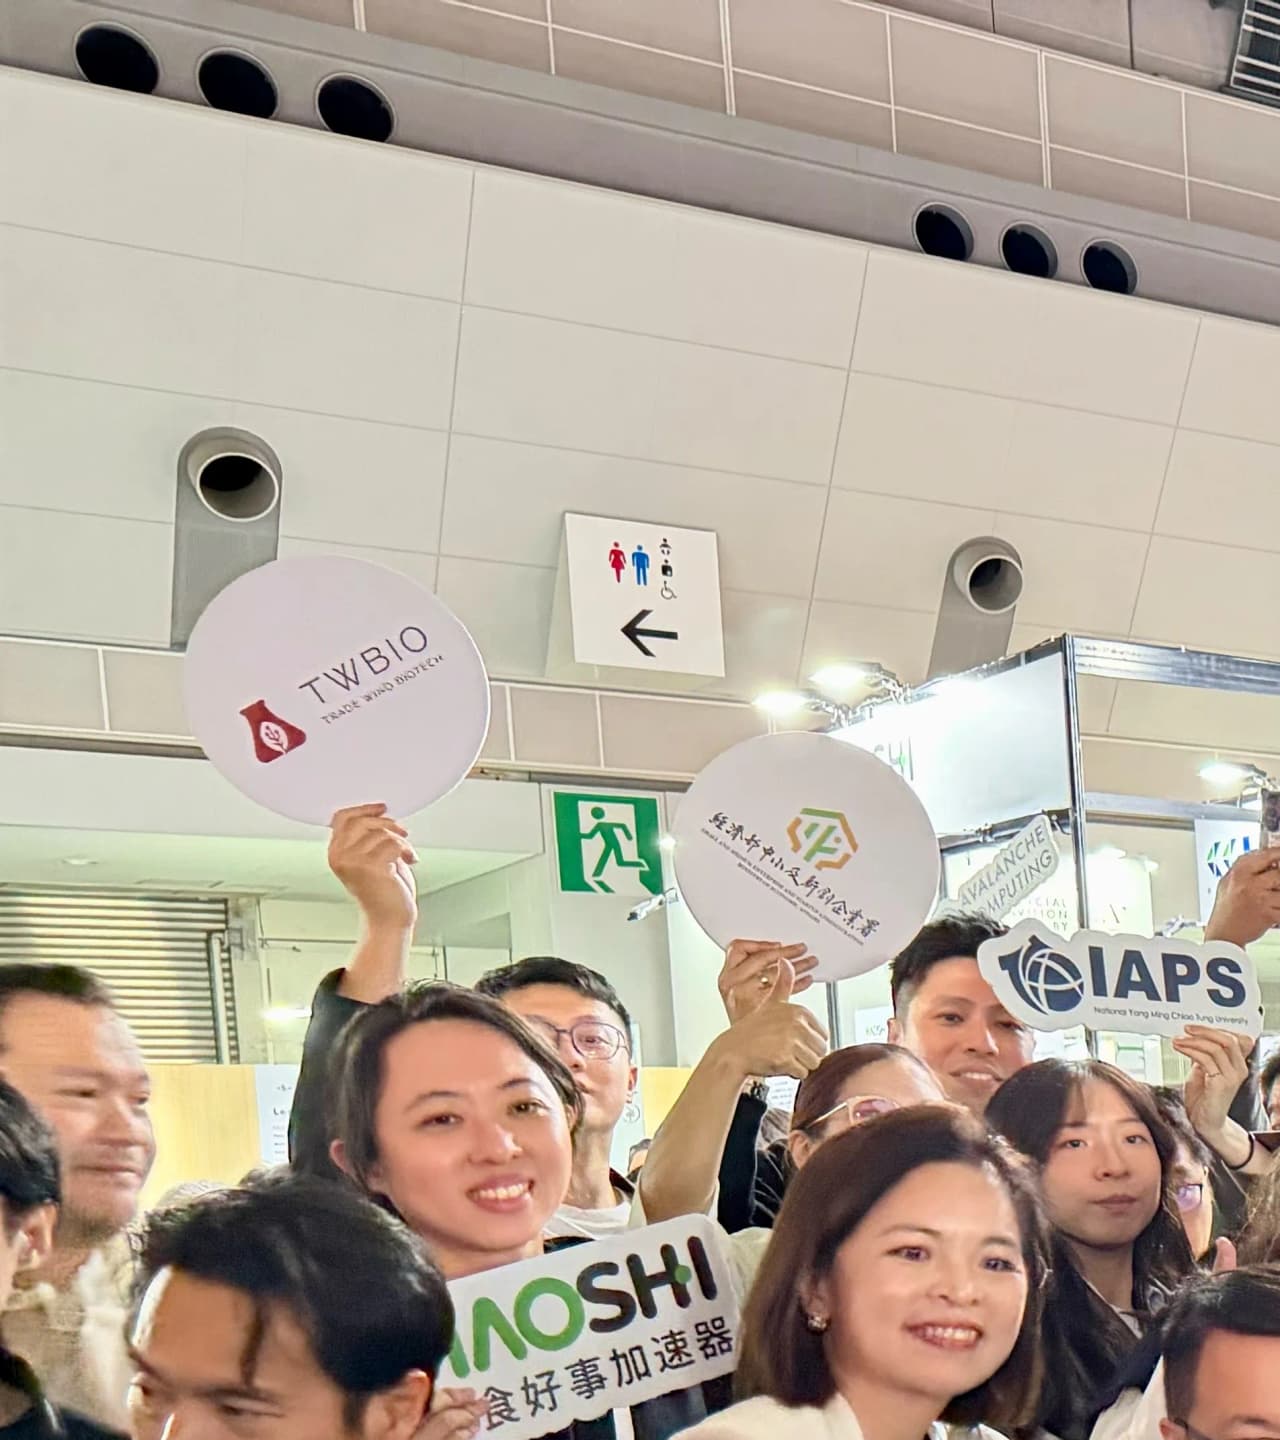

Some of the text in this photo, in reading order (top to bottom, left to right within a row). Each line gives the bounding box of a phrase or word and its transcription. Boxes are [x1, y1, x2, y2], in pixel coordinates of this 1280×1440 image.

[298, 626, 429, 704] TWBIO
[362, 681, 395, 703] WIND
[982, 849, 1052, 913] MPUTING
[1087, 945, 1247, 1008] IAPS
[483, 1314, 735, 1432] 食好事加速器
